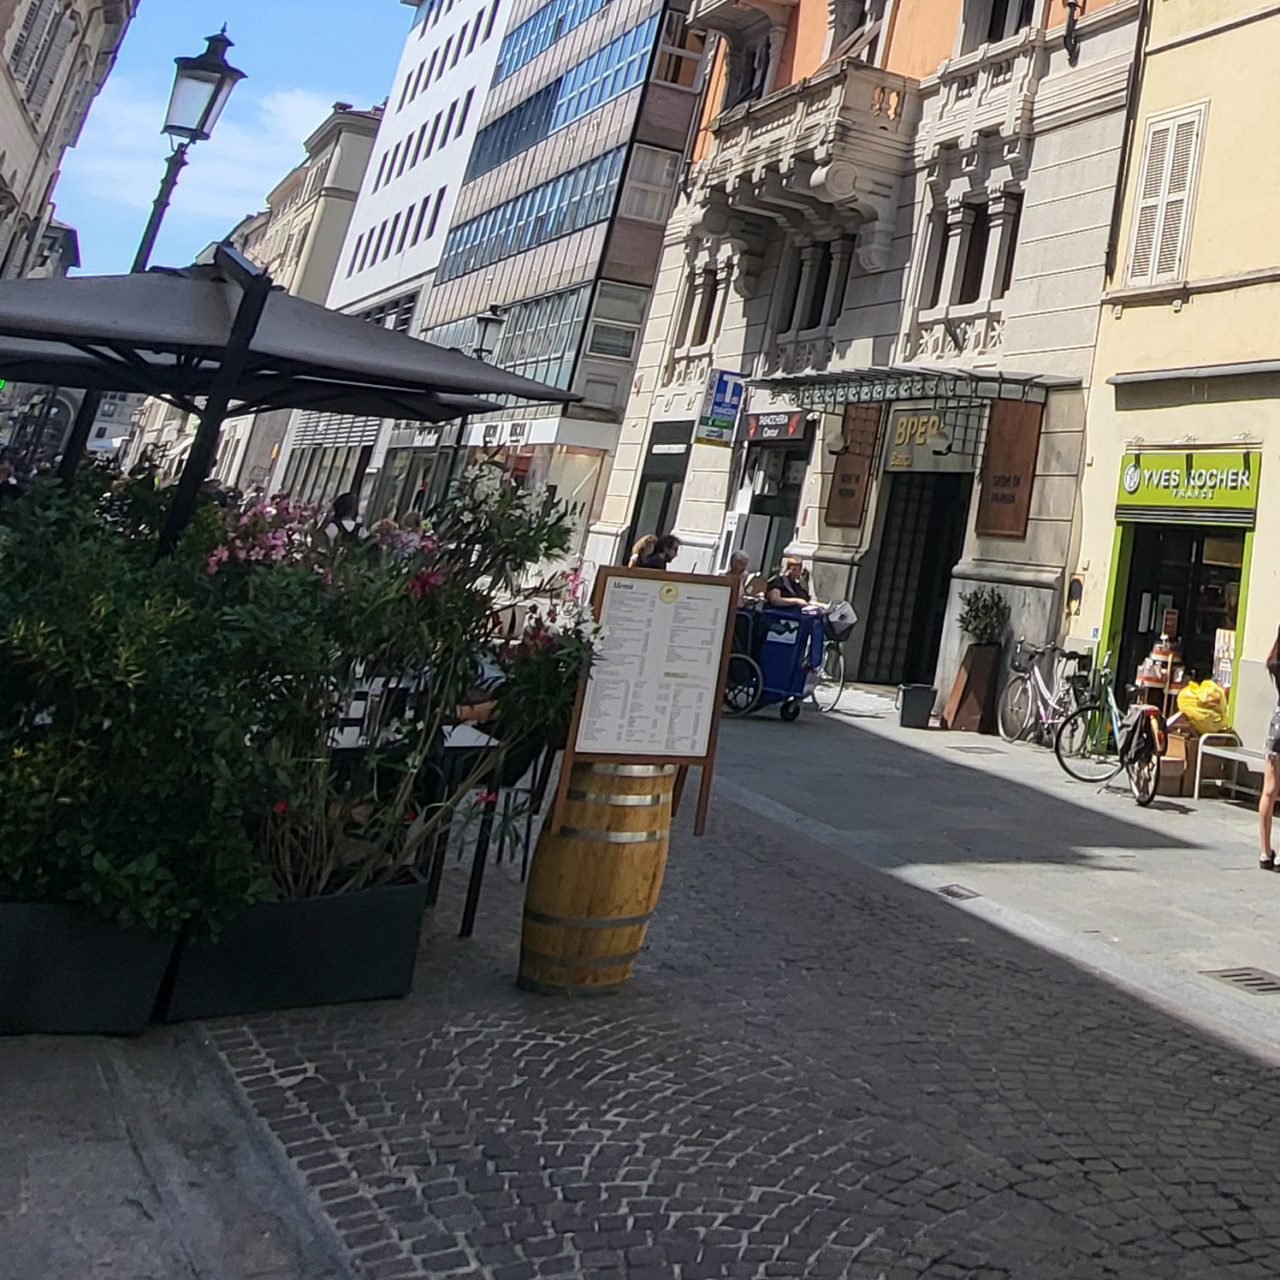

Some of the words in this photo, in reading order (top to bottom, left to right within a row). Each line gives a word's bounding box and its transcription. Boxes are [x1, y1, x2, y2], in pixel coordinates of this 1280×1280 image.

[1143, 469, 1181, 489] YVES
[1184, 469, 1250, 490] ROCHER
[1172, 489, 1214, 499] FRANCE
